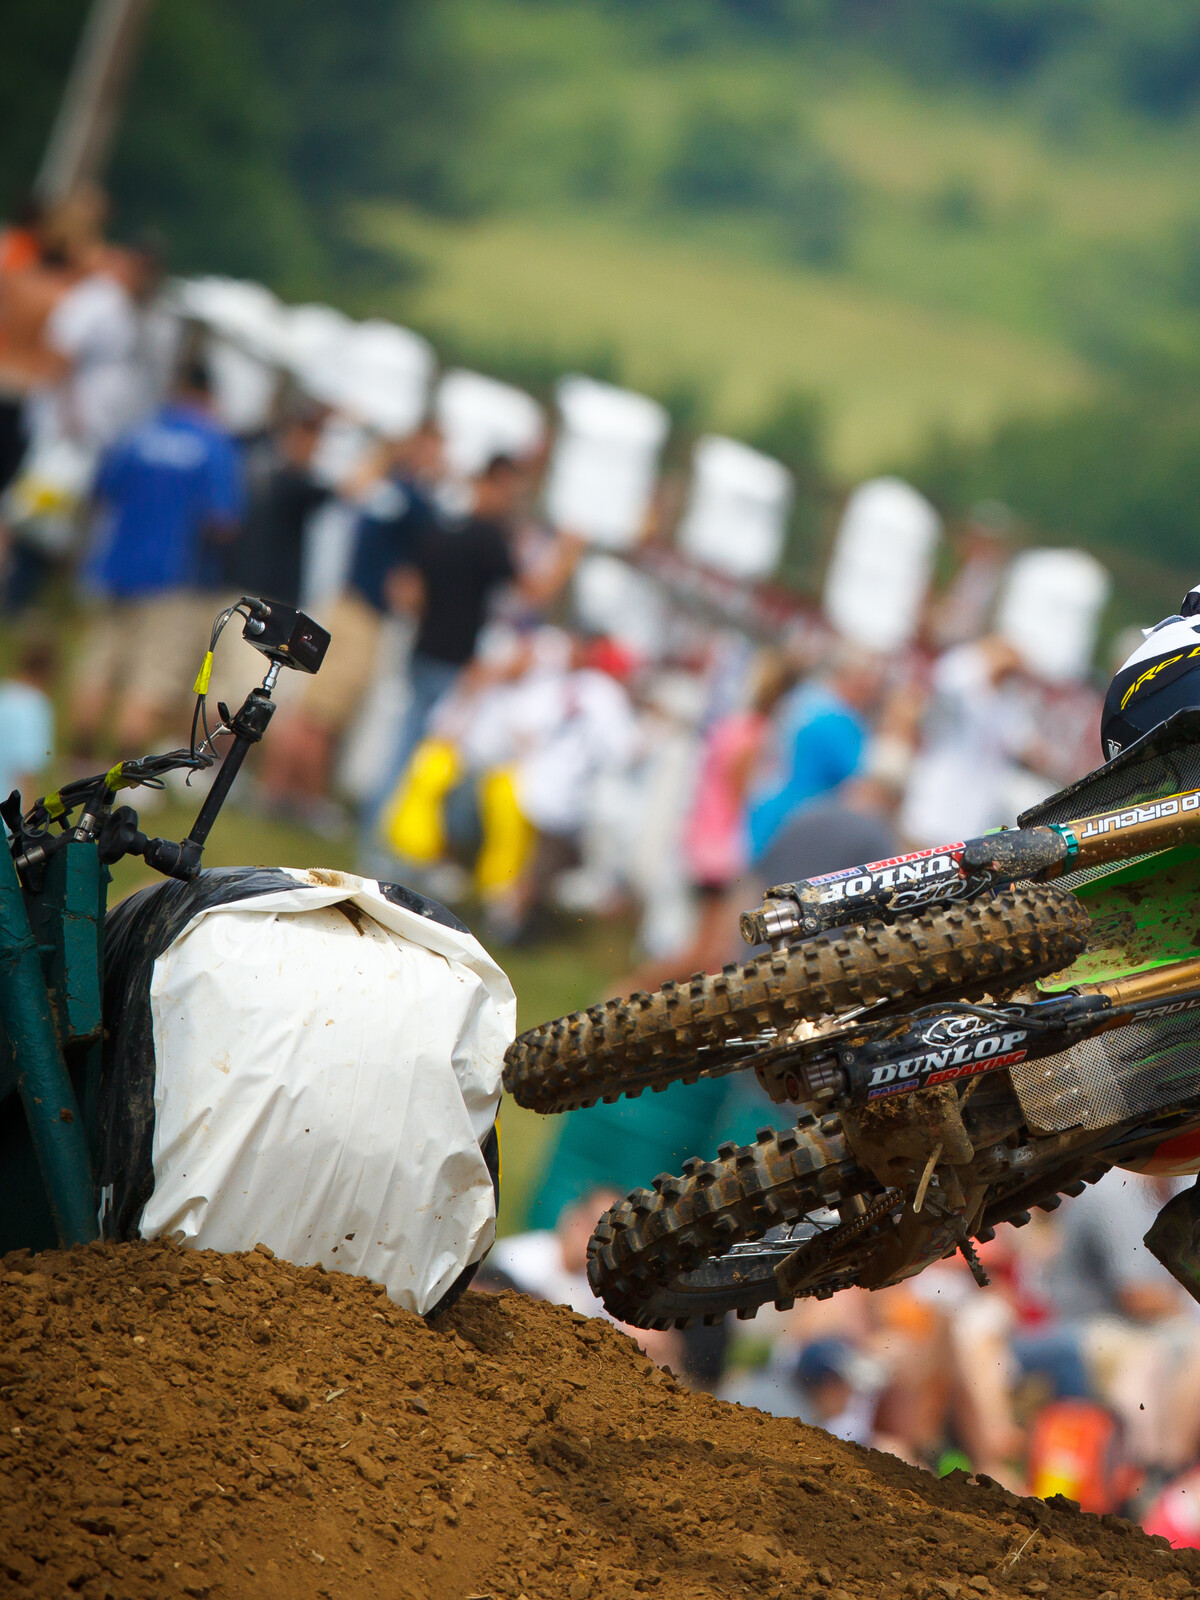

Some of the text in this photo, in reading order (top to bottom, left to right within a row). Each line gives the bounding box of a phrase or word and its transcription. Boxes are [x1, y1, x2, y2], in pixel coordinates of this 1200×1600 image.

[1081, 800, 1179, 839] CIRCUIT
[1130, 1002, 1188, 1024] PRO
[868, 1030, 1028, 1087] DUNLOP
[924, 1050, 1028, 1087] BRAKING
